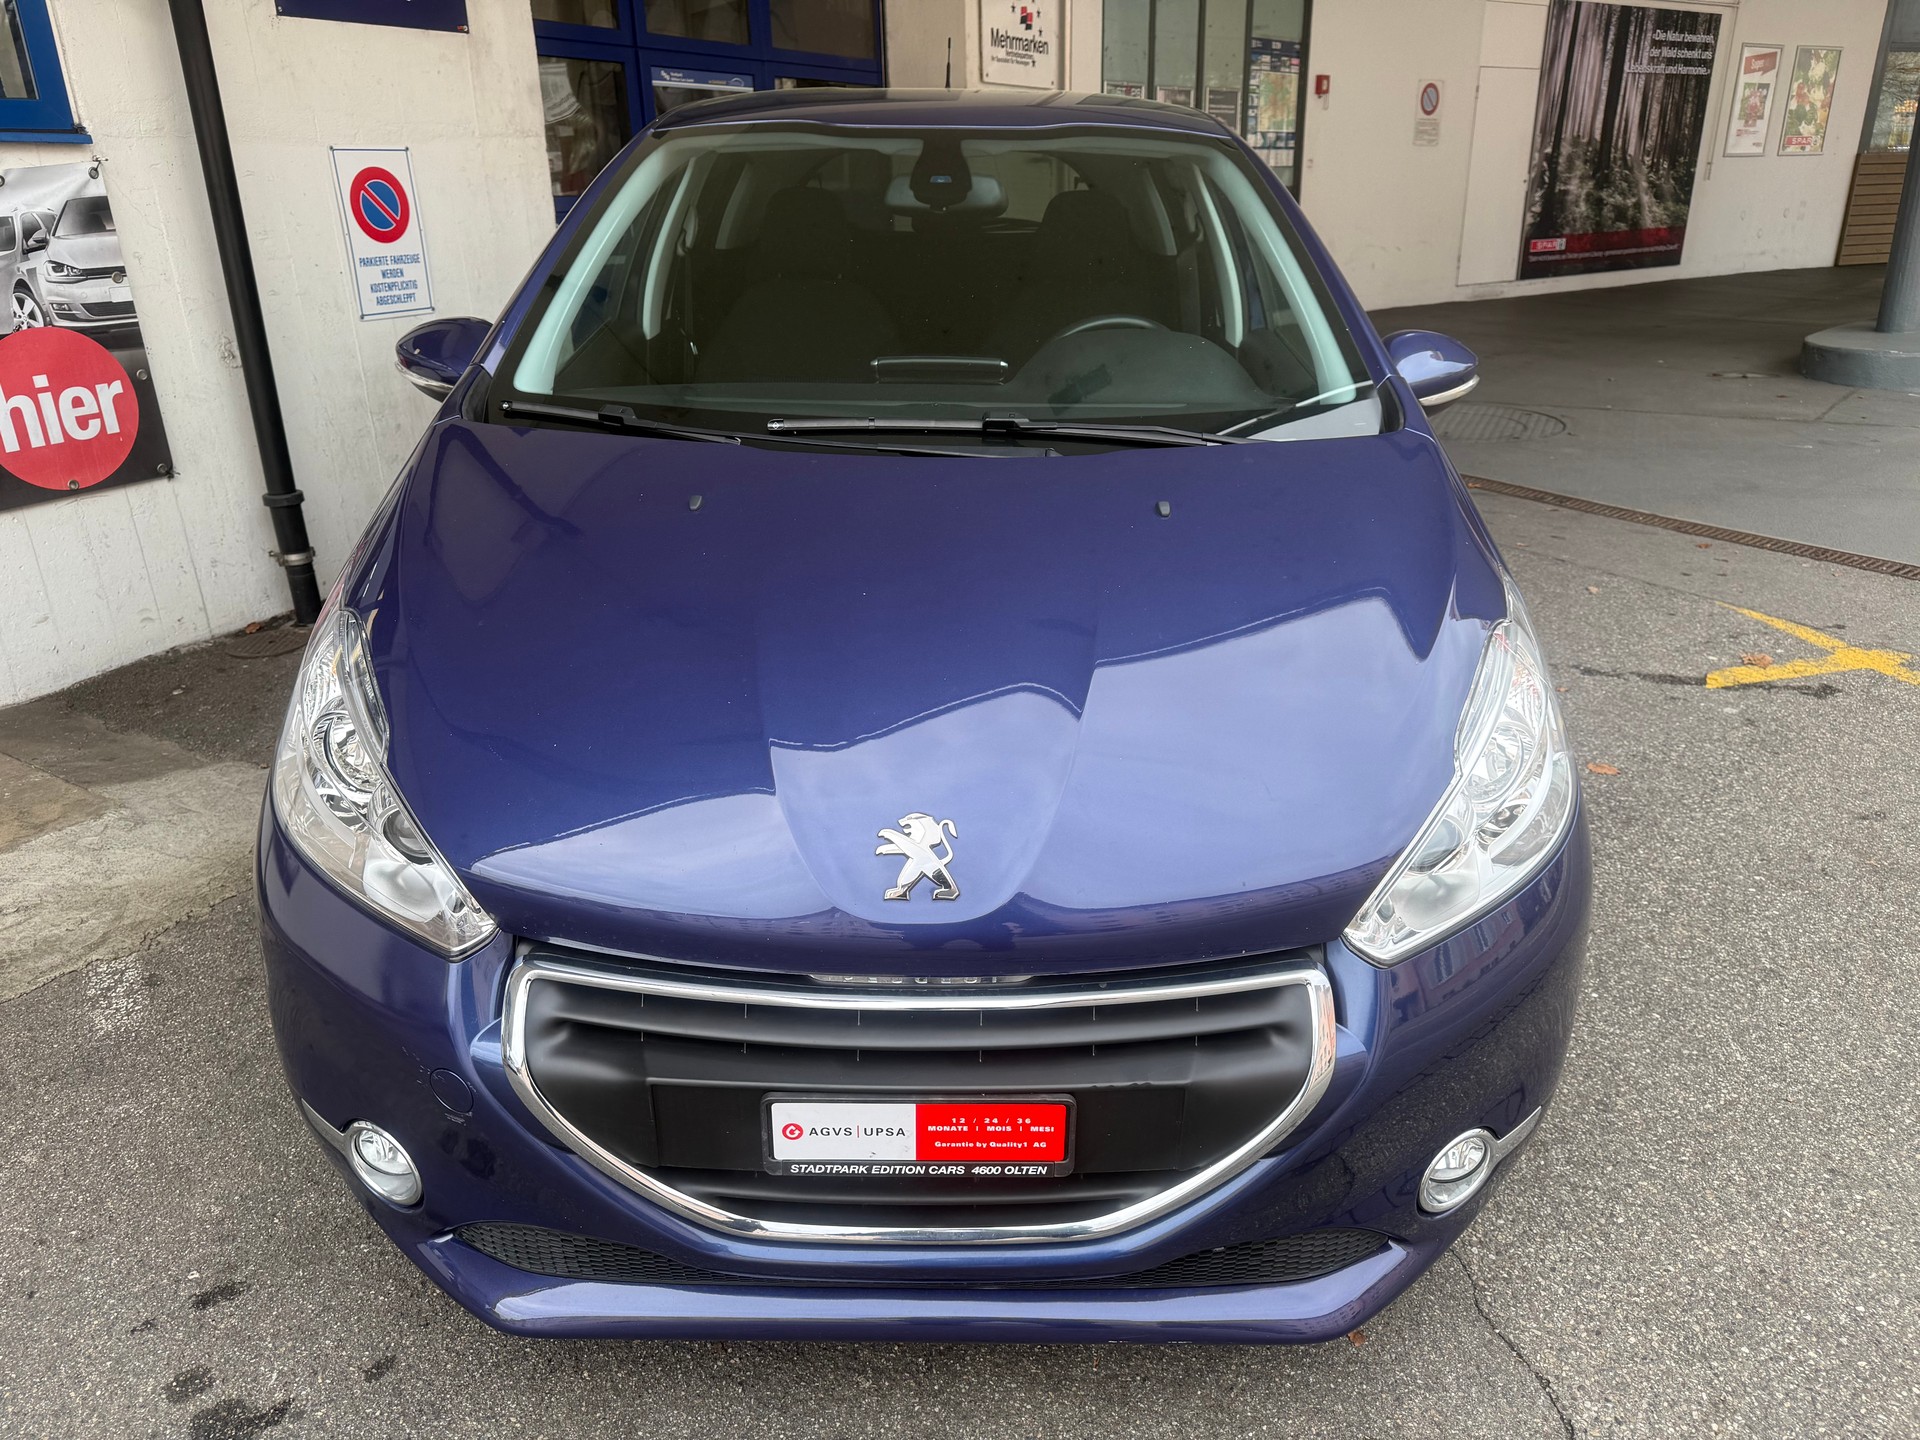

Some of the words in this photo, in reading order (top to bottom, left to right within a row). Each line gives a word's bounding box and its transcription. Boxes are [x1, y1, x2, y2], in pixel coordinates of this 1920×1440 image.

[990, 27, 1049, 55] Mehrmarken
[1666, 30, 1684, 42] Natur
[1661, 46, 1677, 58] Wald
[1677, 47, 1702, 59] schenkt
[1701, 50, 1713, 60] uns
[1791, 137, 1813, 145] SPAR
[1536, 242, 1557, 250] SPAR
[359, 256, 389, 267] PARKIERTE
[390, 253, 420, 265] FAHRZEUGE
[381, 268, 404, 279] WERDEN
[370, 279, 418, 293] KOSTENPFLICHTIG
[376, 292, 416, 306] ABGESCHLEPPT
[0, 374, 124, 453] hier
[809, 1127, 852, 1137] AGVS
[864, 1127, 906, 1137] UPSA
[976, 1141, 987, 1149] by
[989, 1141, 1028, 1149] Quality1
[790, 1164, 868, 1174] STADTPARK
[871, 1165, 926, 1175] EDITION
[928, 1165, 966, 1175] CARS
[971, 1165, 1002, 1175] 4600
[1004, 1165, 1048, 1175] OLTEN
